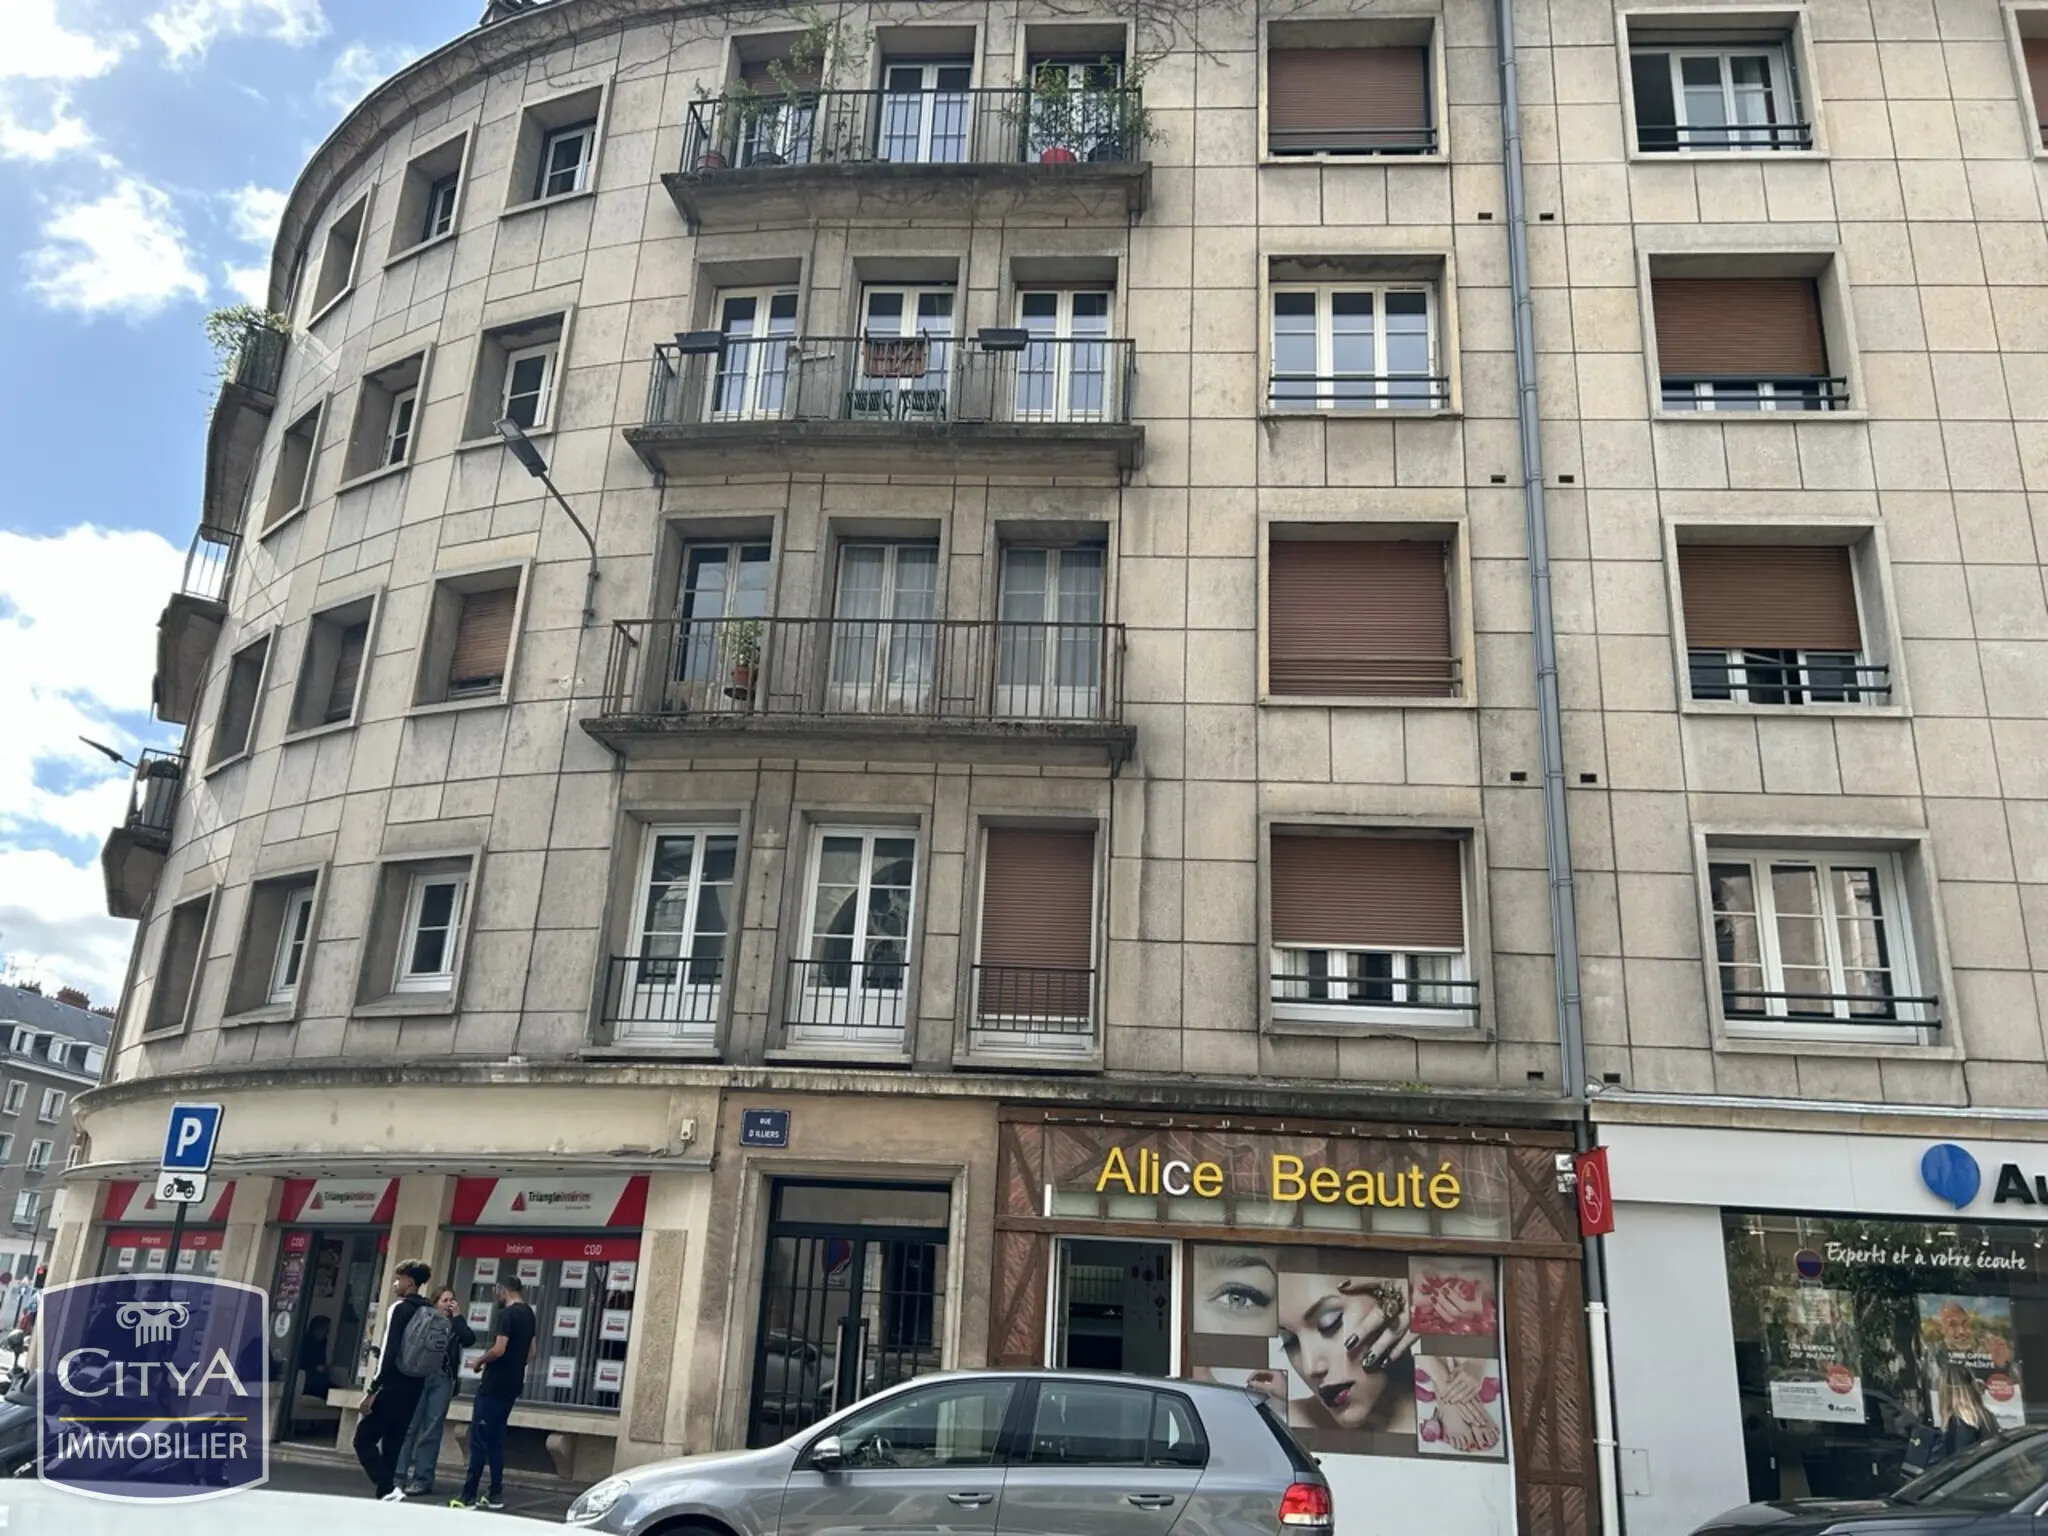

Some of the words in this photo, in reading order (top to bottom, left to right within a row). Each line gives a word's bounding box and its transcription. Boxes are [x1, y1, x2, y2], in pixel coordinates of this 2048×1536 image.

[759, 1117, 772, 1126] RUE
[175, 1117, 202, 1157] P
[1096, 1146, 1224, 1198] Alice
[1271, 1154, 1461, 1209] Beauté
[505, 1243, 534, 1254] Intérim
[1824, 1241, 1886, 1268] Experts
[1892, 1248, 1909, 1265] et
[1915, 1248, 1927, 1265] à
[1930, 1249, 1972, 1267] votre
[1977, 1250, 2028, 1270] écoute
